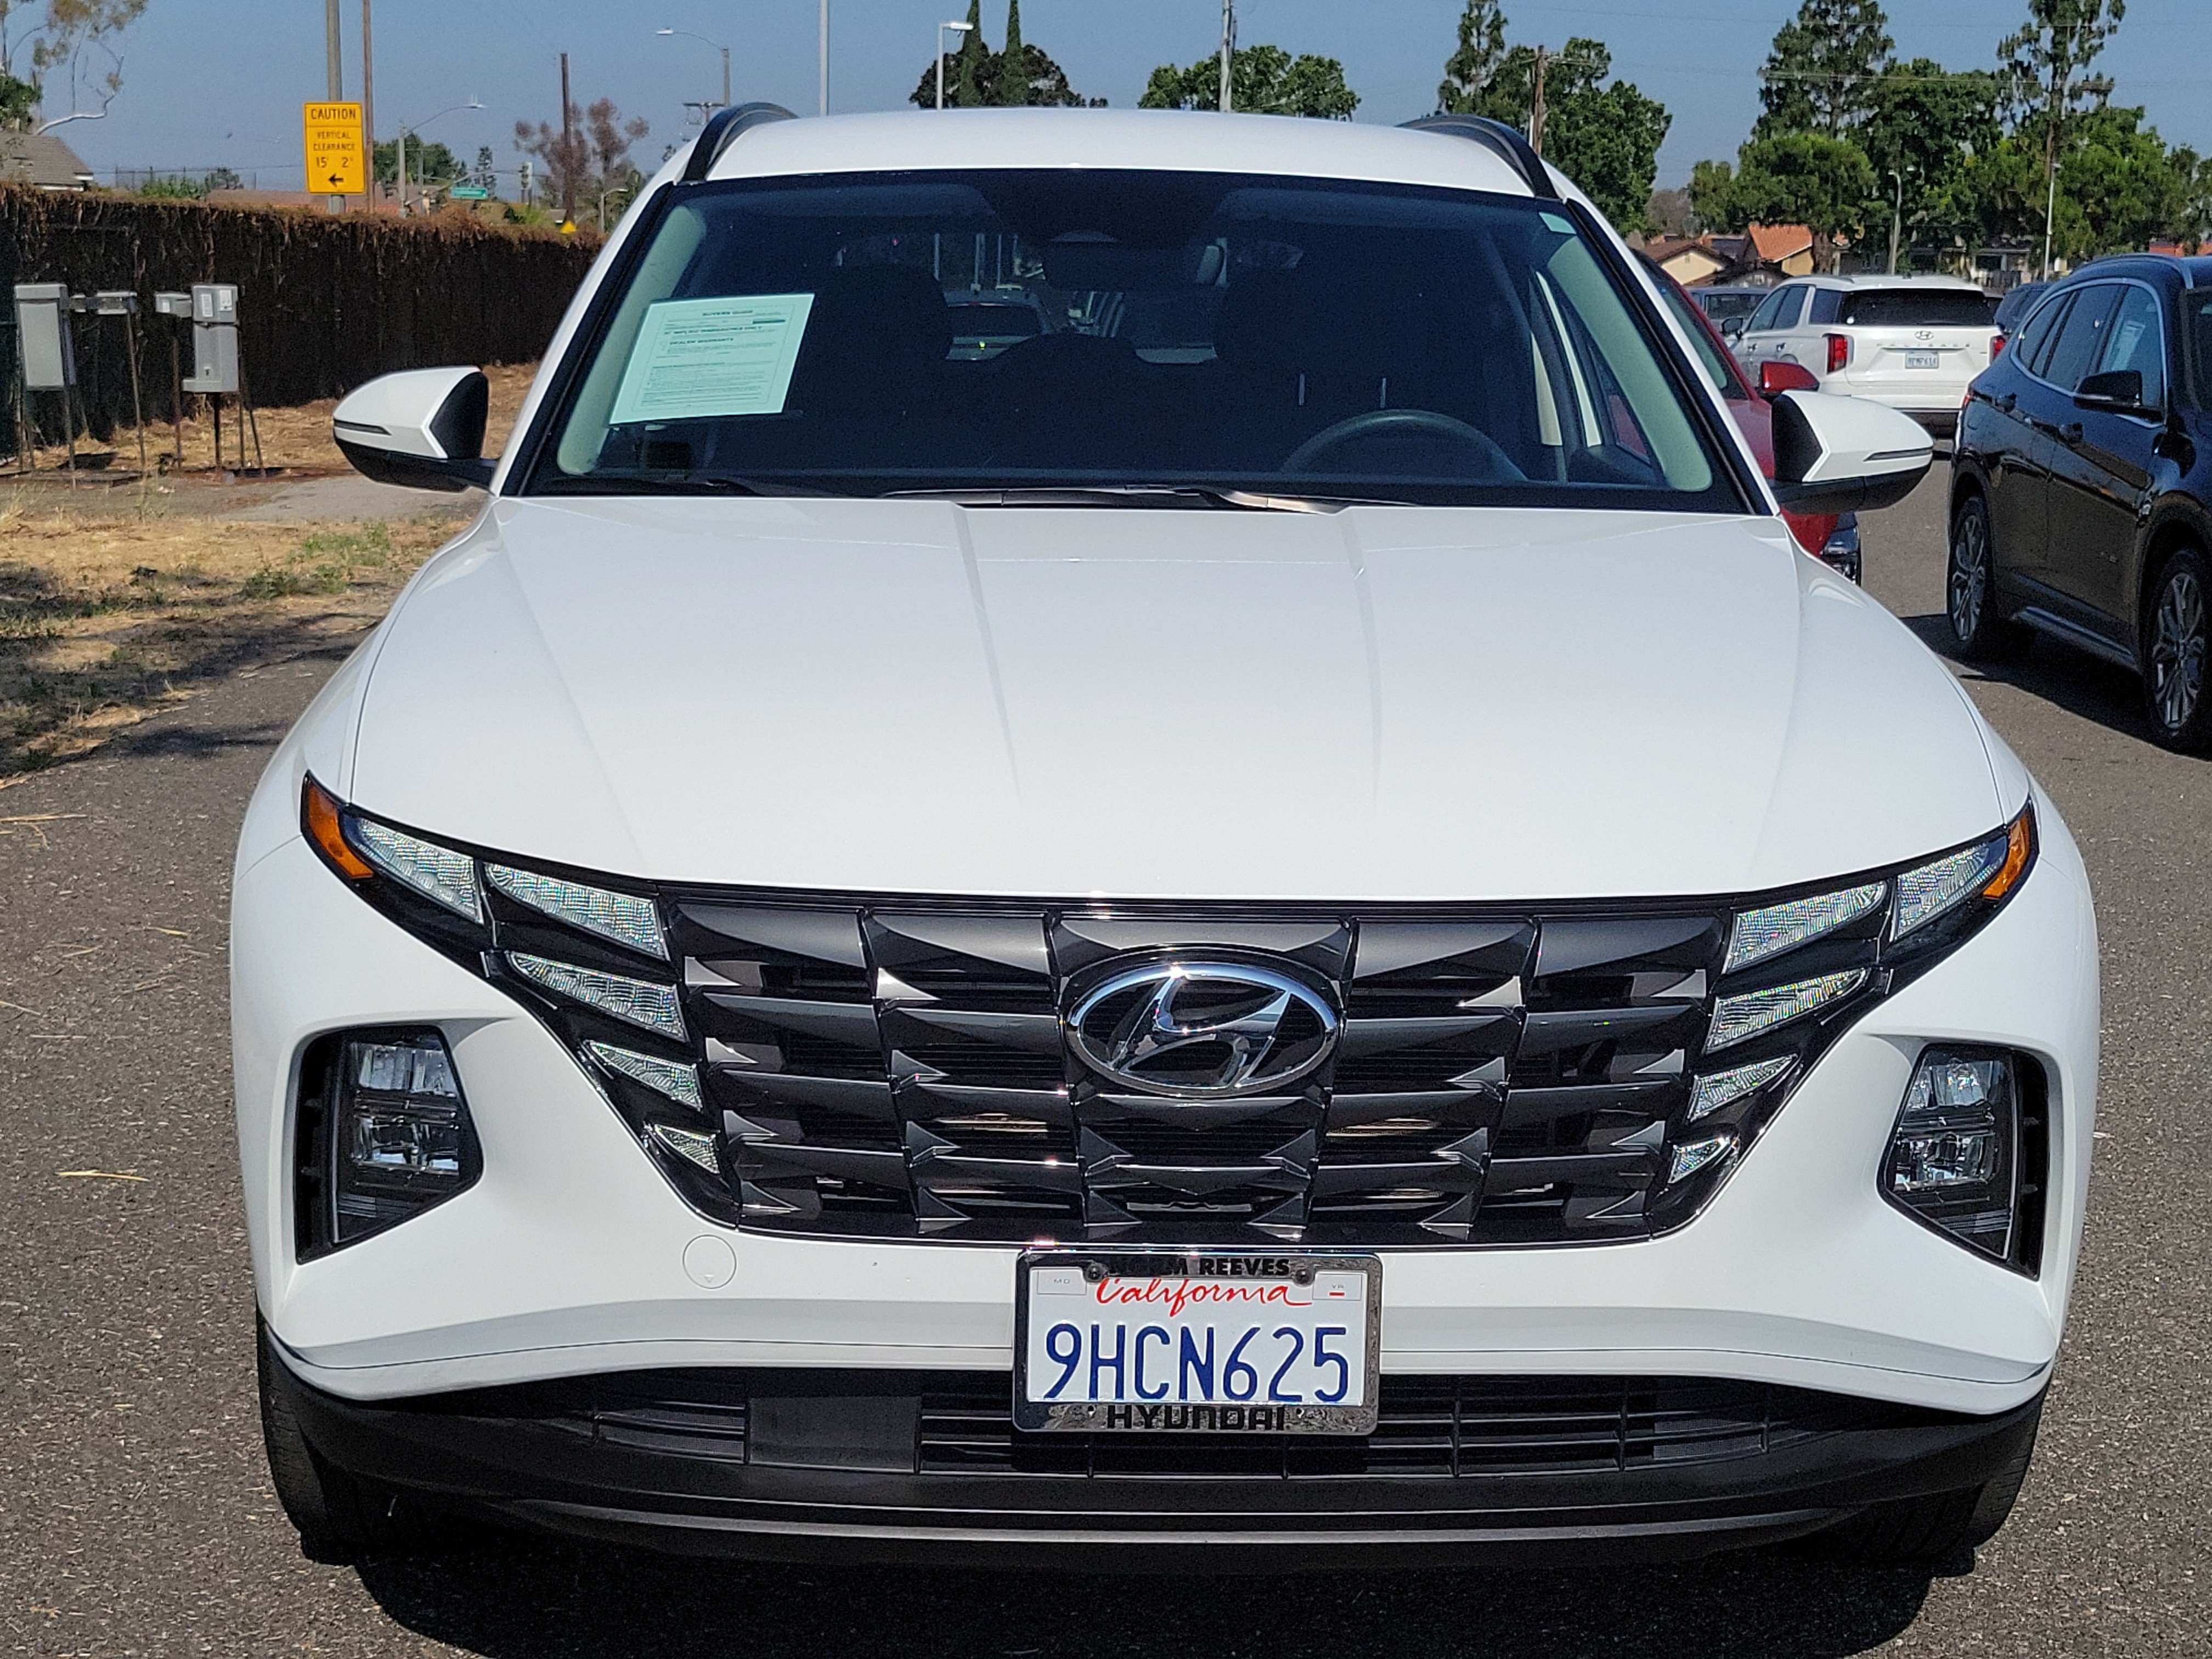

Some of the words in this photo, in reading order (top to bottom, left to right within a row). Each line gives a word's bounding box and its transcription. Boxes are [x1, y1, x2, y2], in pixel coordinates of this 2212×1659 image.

[311, 109, 356, 120] CAUTION
[314, 143, 355, 151] CLEARANCE
[1199, 1257, 1289, 1276] REEVES
[1096, 1278, 1311, 1317] California
[1043, 1323, 1349, 1402] 9HCN625
[1107, 1404, 1285, 1430] HYUNDAI
